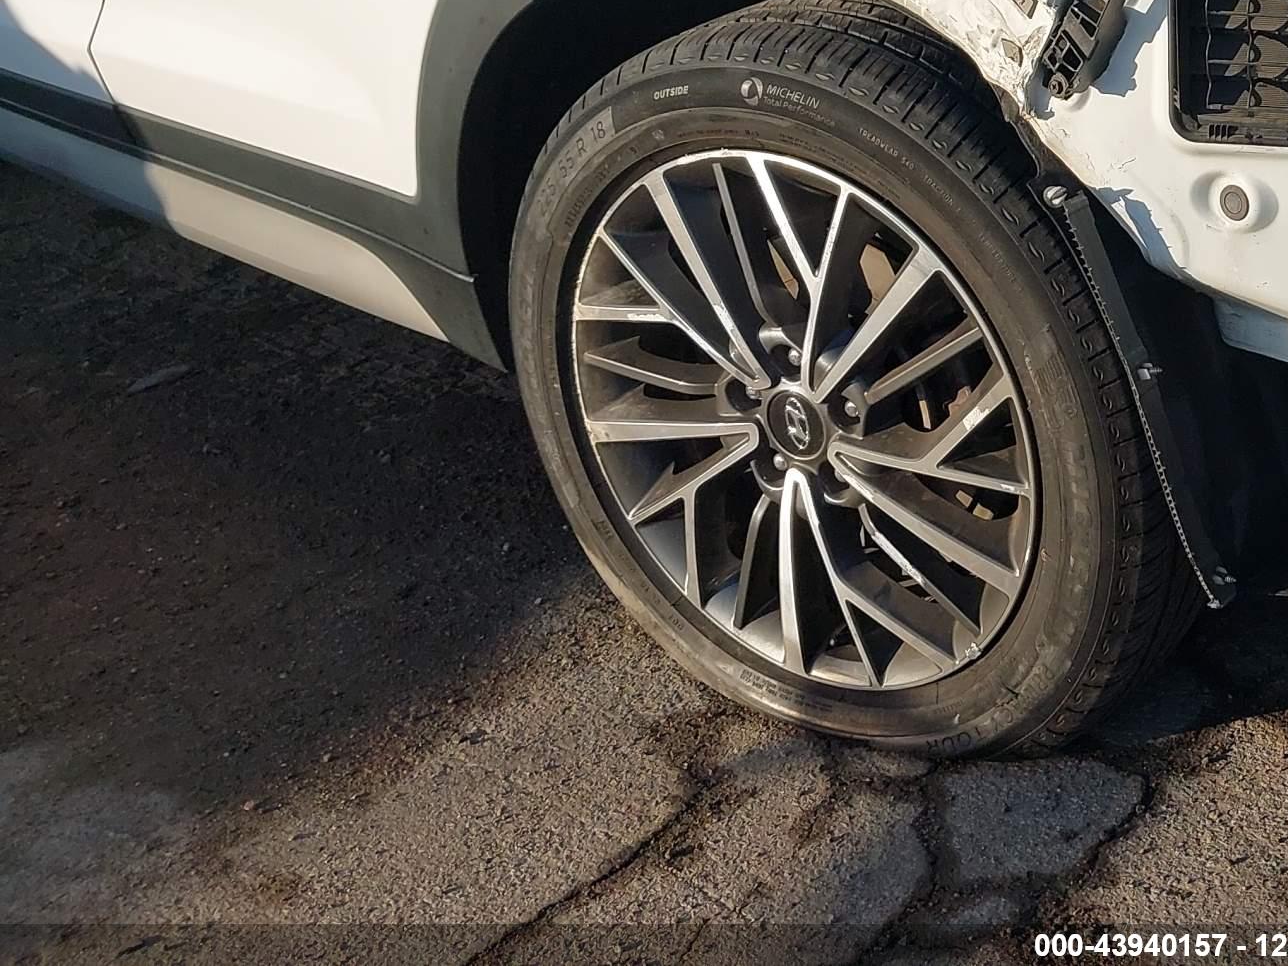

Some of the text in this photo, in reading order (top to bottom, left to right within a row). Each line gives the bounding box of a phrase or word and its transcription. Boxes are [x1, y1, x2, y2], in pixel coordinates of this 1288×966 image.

[653, 85, 689, 100] OUTSIDE
[766, 84, 820, 109] MICHELIN
[763, 96, 783, 108] Total
[590, 121, 606, 143] 18
